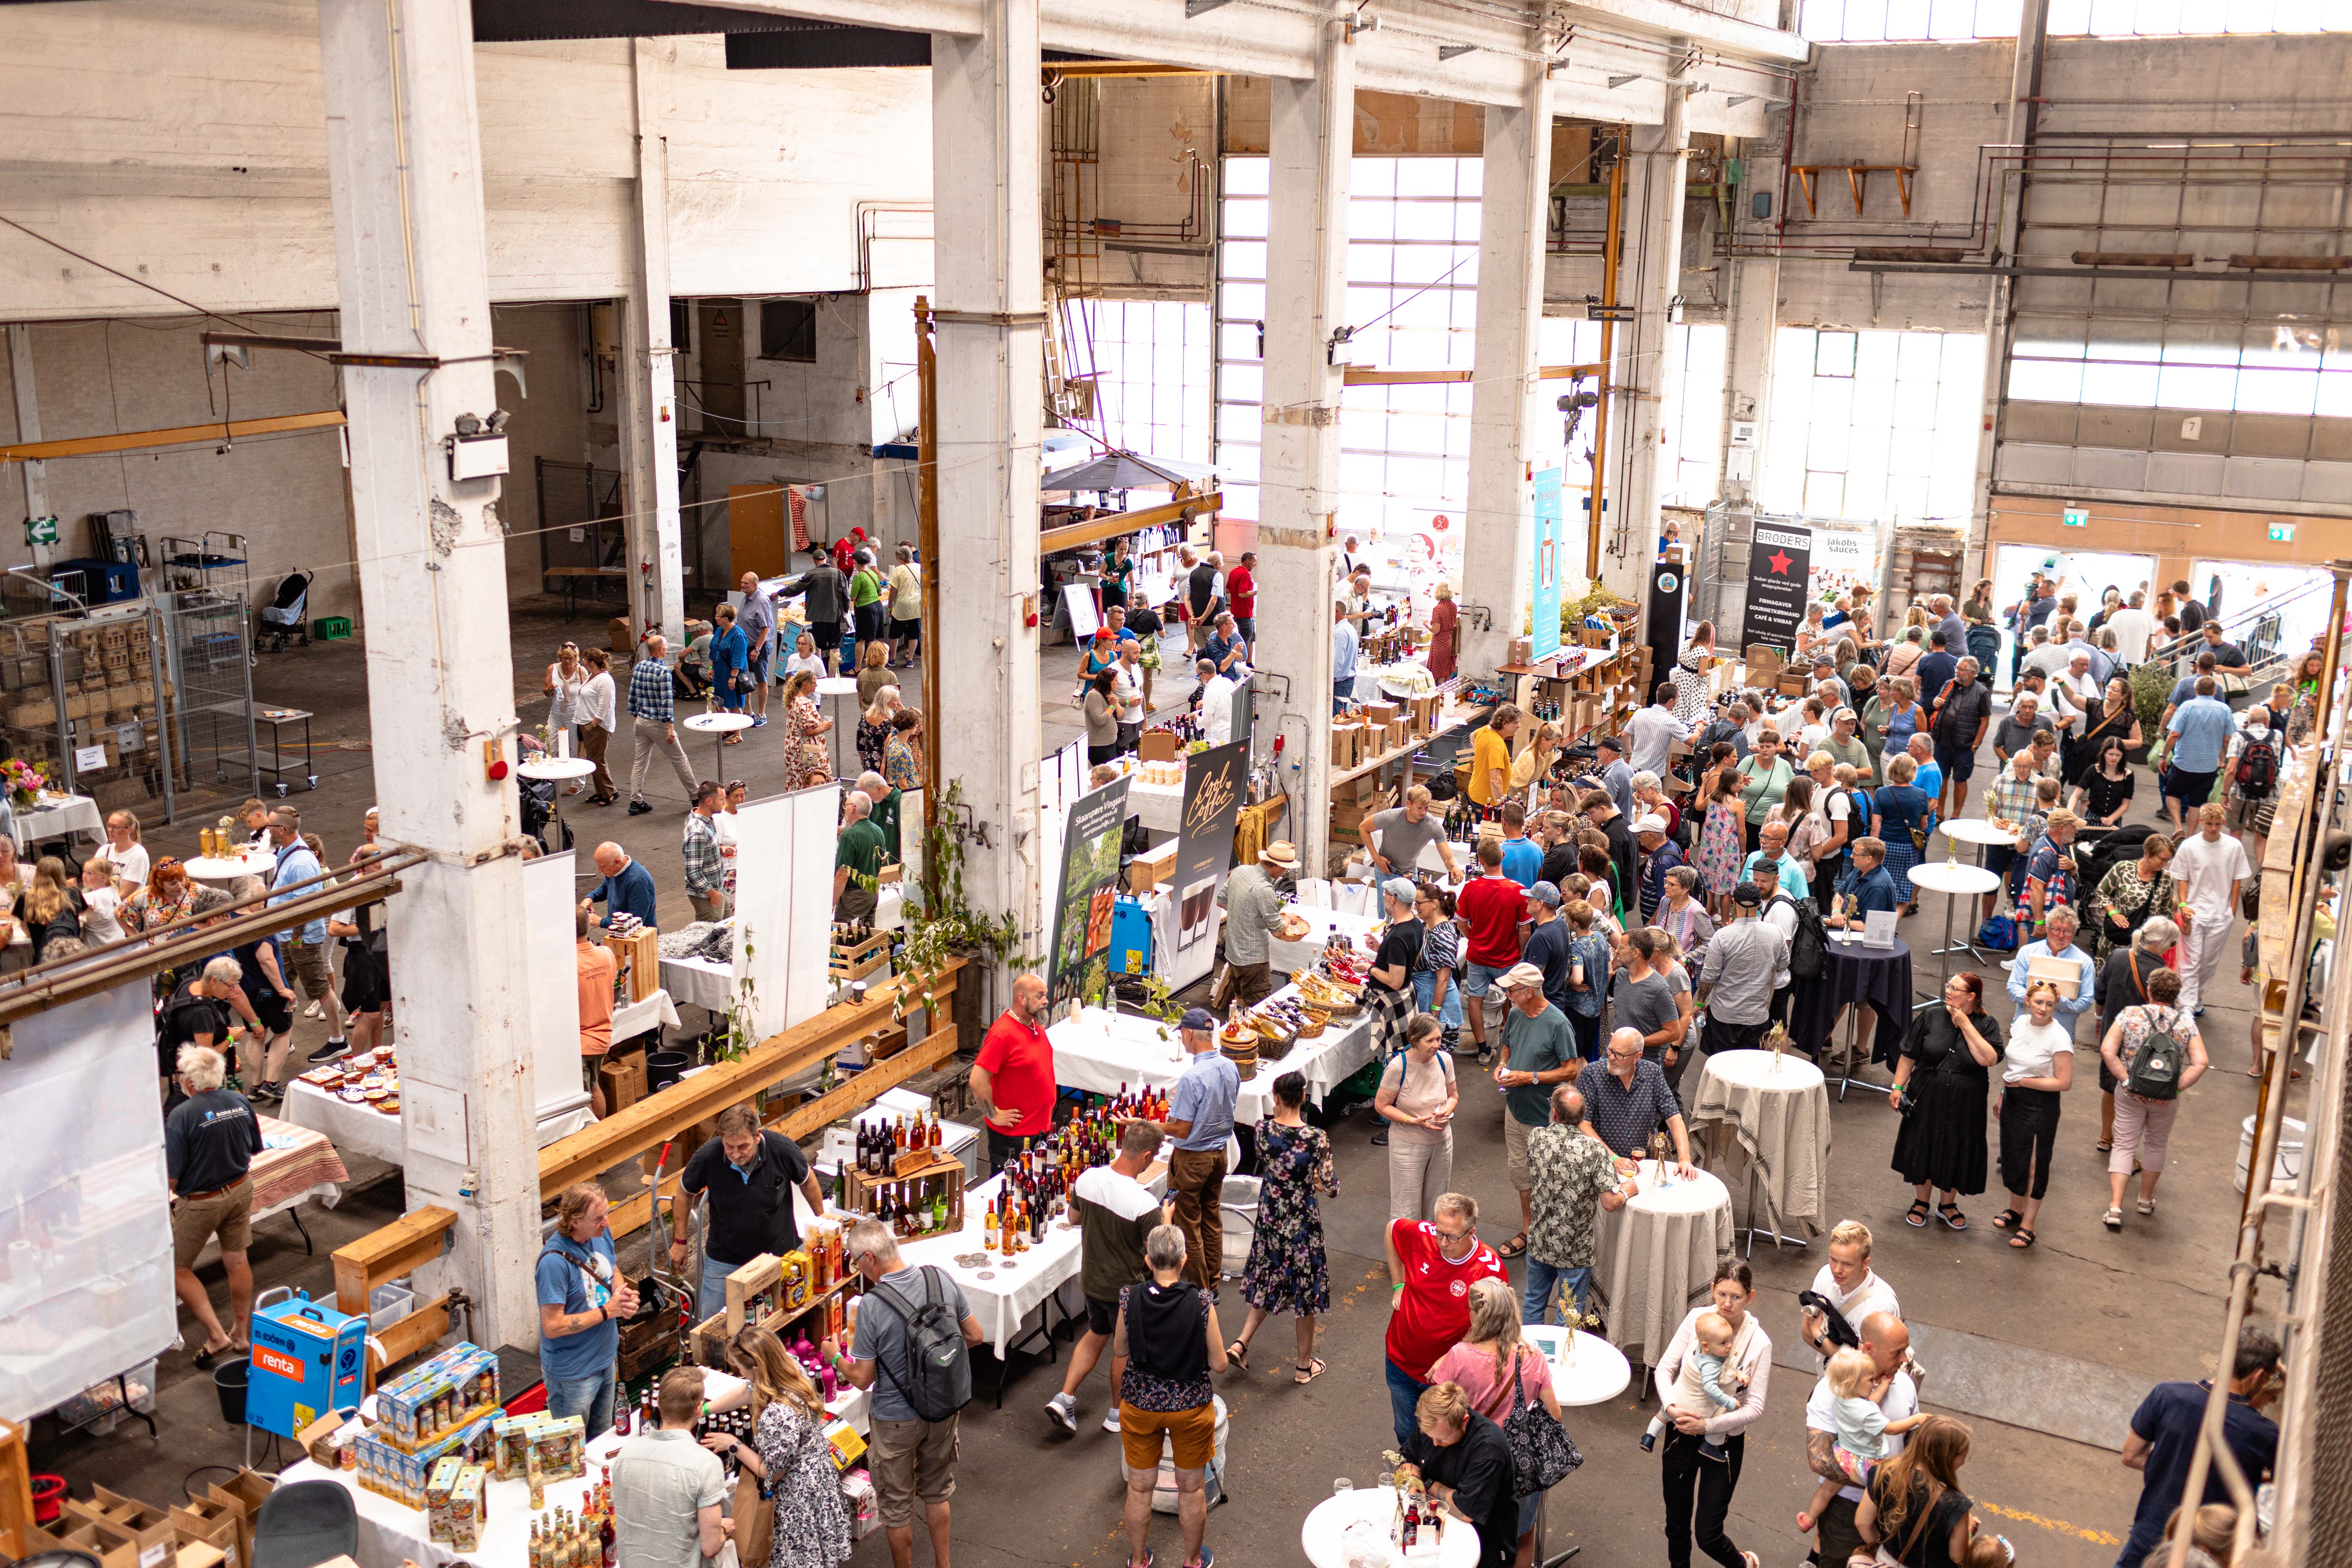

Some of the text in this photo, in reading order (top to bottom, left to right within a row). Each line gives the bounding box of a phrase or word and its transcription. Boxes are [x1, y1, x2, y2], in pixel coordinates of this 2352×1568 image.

[2189, 422, 2196, 432] 7
[1758, 531, 1808, 547] BRODERS
[1827, 538, 1857, 547] Jakobs
[1759, 598, 1792, 608] FIRMAGAVER
[1749, 605, 1800, 618] GOURMETKØBMAND
[1195, 760, 1230, 804] Cool
[1076, 792, 1126, 826] Skaarupøre Vingaard
[1187, 787, 1234, 828] Coffee
[216, 1107, 244, 1117] BOREALIS
[291, 1319, 327, 1334] renta
[263, 1353, 294, 1374] renta
[342, 1376, 353, 1385] renta
[248, 1412, 264, 1425] U 32
